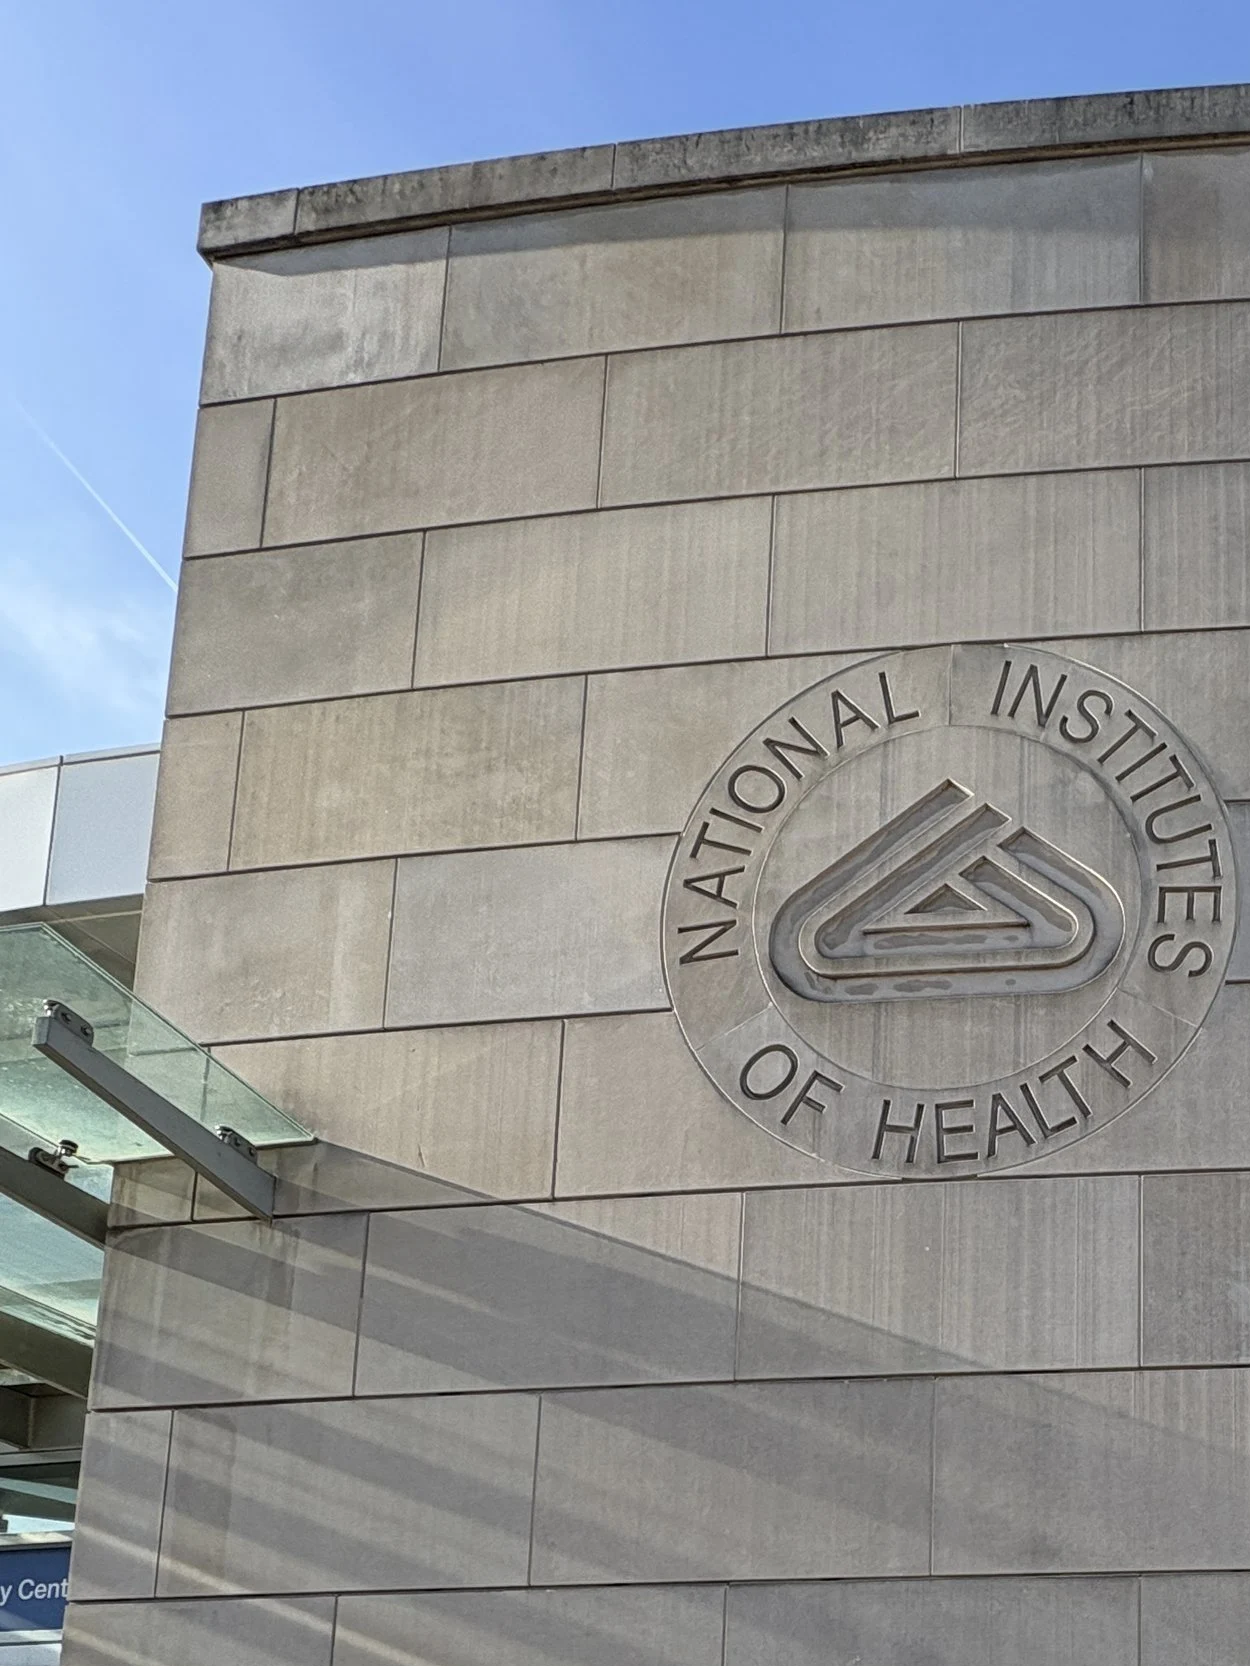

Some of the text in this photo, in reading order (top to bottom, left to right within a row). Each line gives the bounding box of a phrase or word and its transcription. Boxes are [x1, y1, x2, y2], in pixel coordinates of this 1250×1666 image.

[677, 660, 1223, 979] NATIONAL INSTITUTES
[739, 1019, 1159, 1165] OF HEALTH
